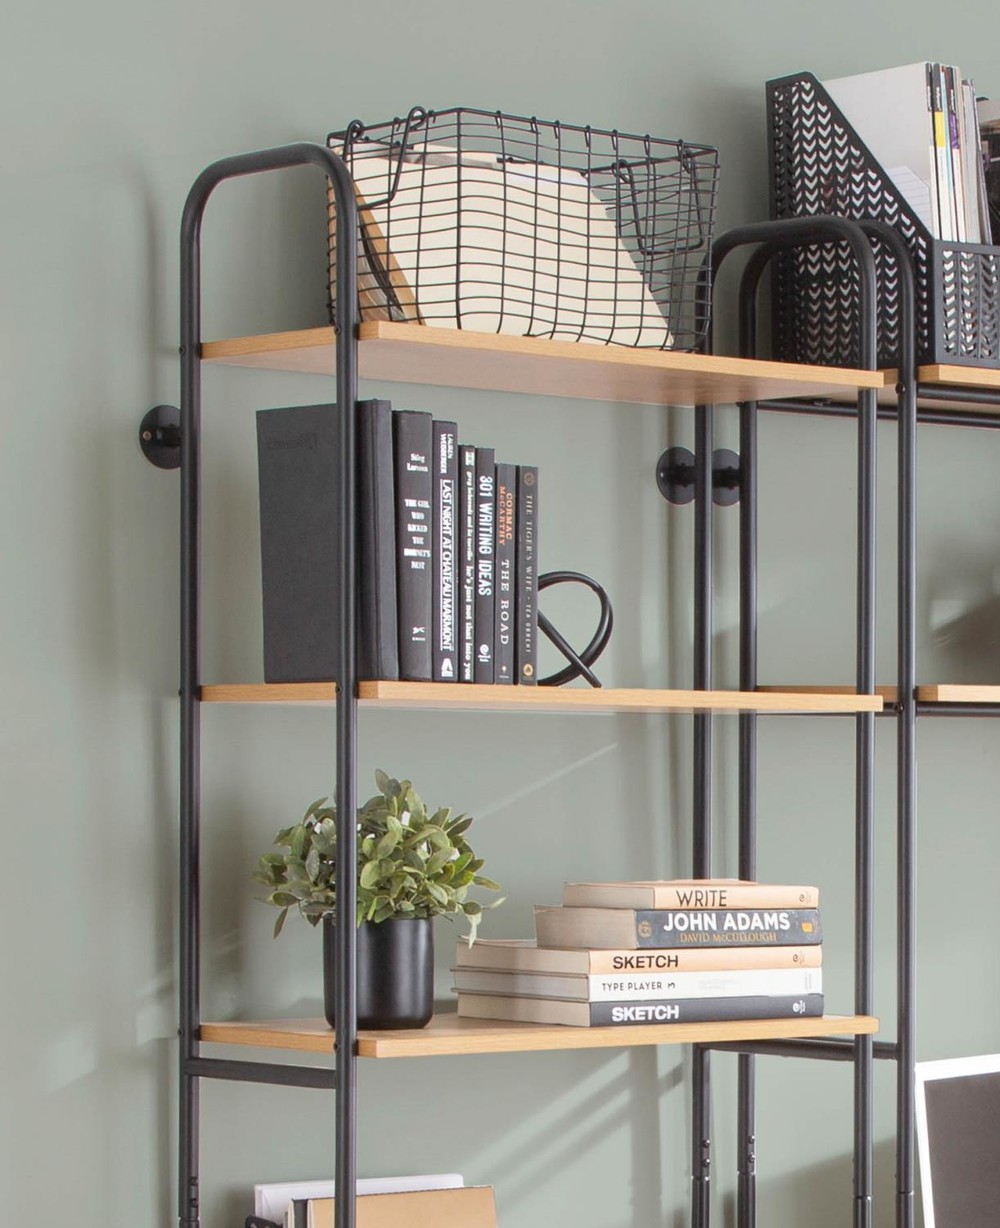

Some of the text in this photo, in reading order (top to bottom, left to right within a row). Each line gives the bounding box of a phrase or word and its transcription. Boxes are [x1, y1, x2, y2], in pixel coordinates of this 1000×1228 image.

[498, 484, 506, 545] McCARTHY
[505, 492, 513, 540] CORMAC
[525, 495, 533, 515] THE
[478, 475, 493, 596] 301 WRITING IDEAS
[525, 521, 533, 561] TIGER'S
[442, 479, 452, 650] LAST NIGHT AT CHATEAU MARMONT
[525, 566, 533, 592] WIFE
[500, 559, 510, 645] THE ROAD
[463, 565, 473, 680] he's just not that into you
[676, 889, 728, 908] WRITE
[662, 912, 791, 932] JOHN ADAMS
[679, 932, 710, 943] DAVID
[612, 954, 679, 969] SKETCH
[601, 982, 625, 992] TYPE
[627, 981, 663, 991] PLAYER
[611, 1004, 680, 1022] SKETCH
